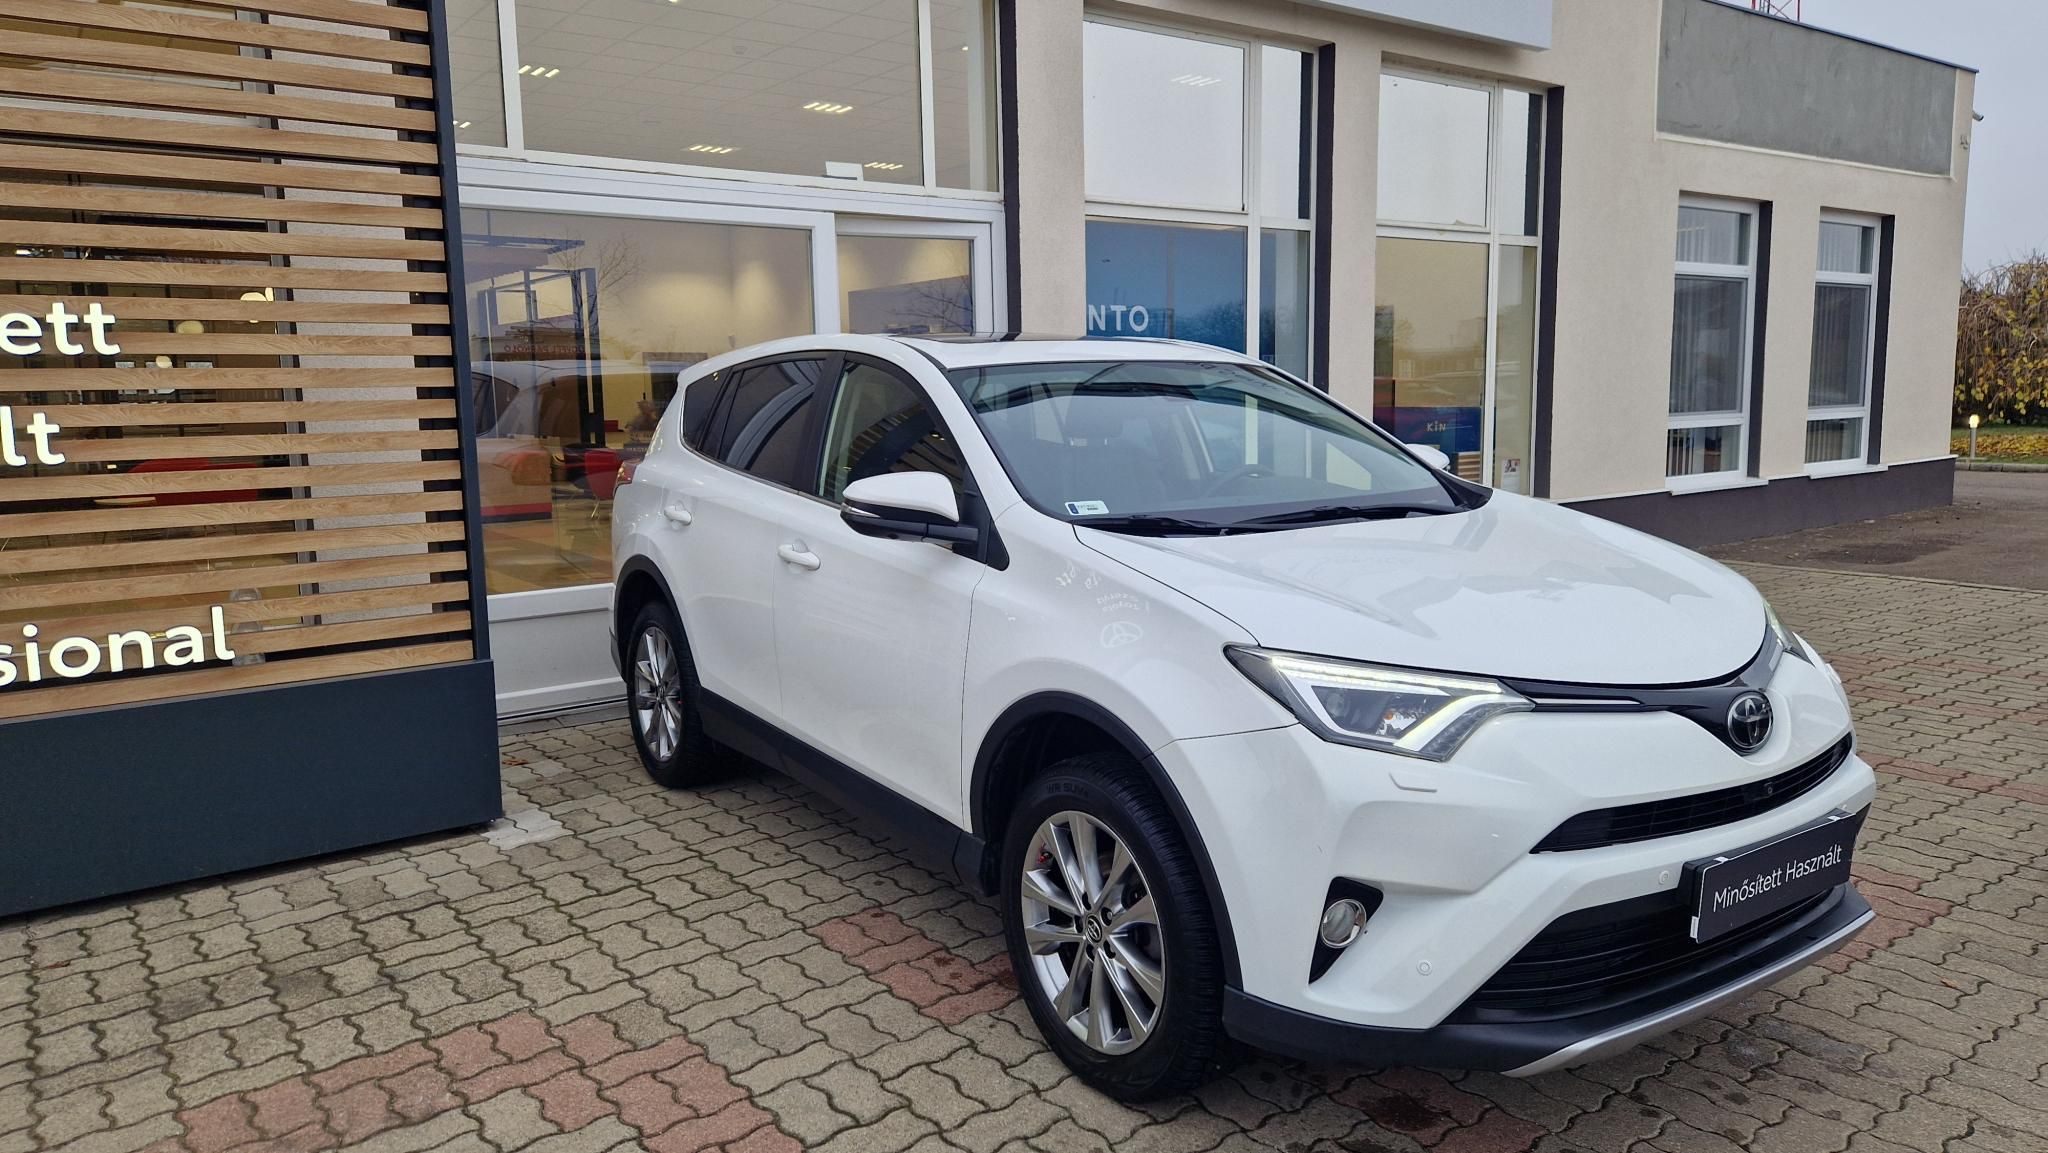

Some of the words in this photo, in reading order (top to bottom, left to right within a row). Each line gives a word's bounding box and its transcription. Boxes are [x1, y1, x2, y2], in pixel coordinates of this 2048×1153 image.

[0, 302, 121, 355] ett
[1088, 304, 1149, 332] NTO
[0, 405, 66, 466] lt
[1713, 867, 1782, 912] Minősített
[1785, 844, 1842, 882] Használt
